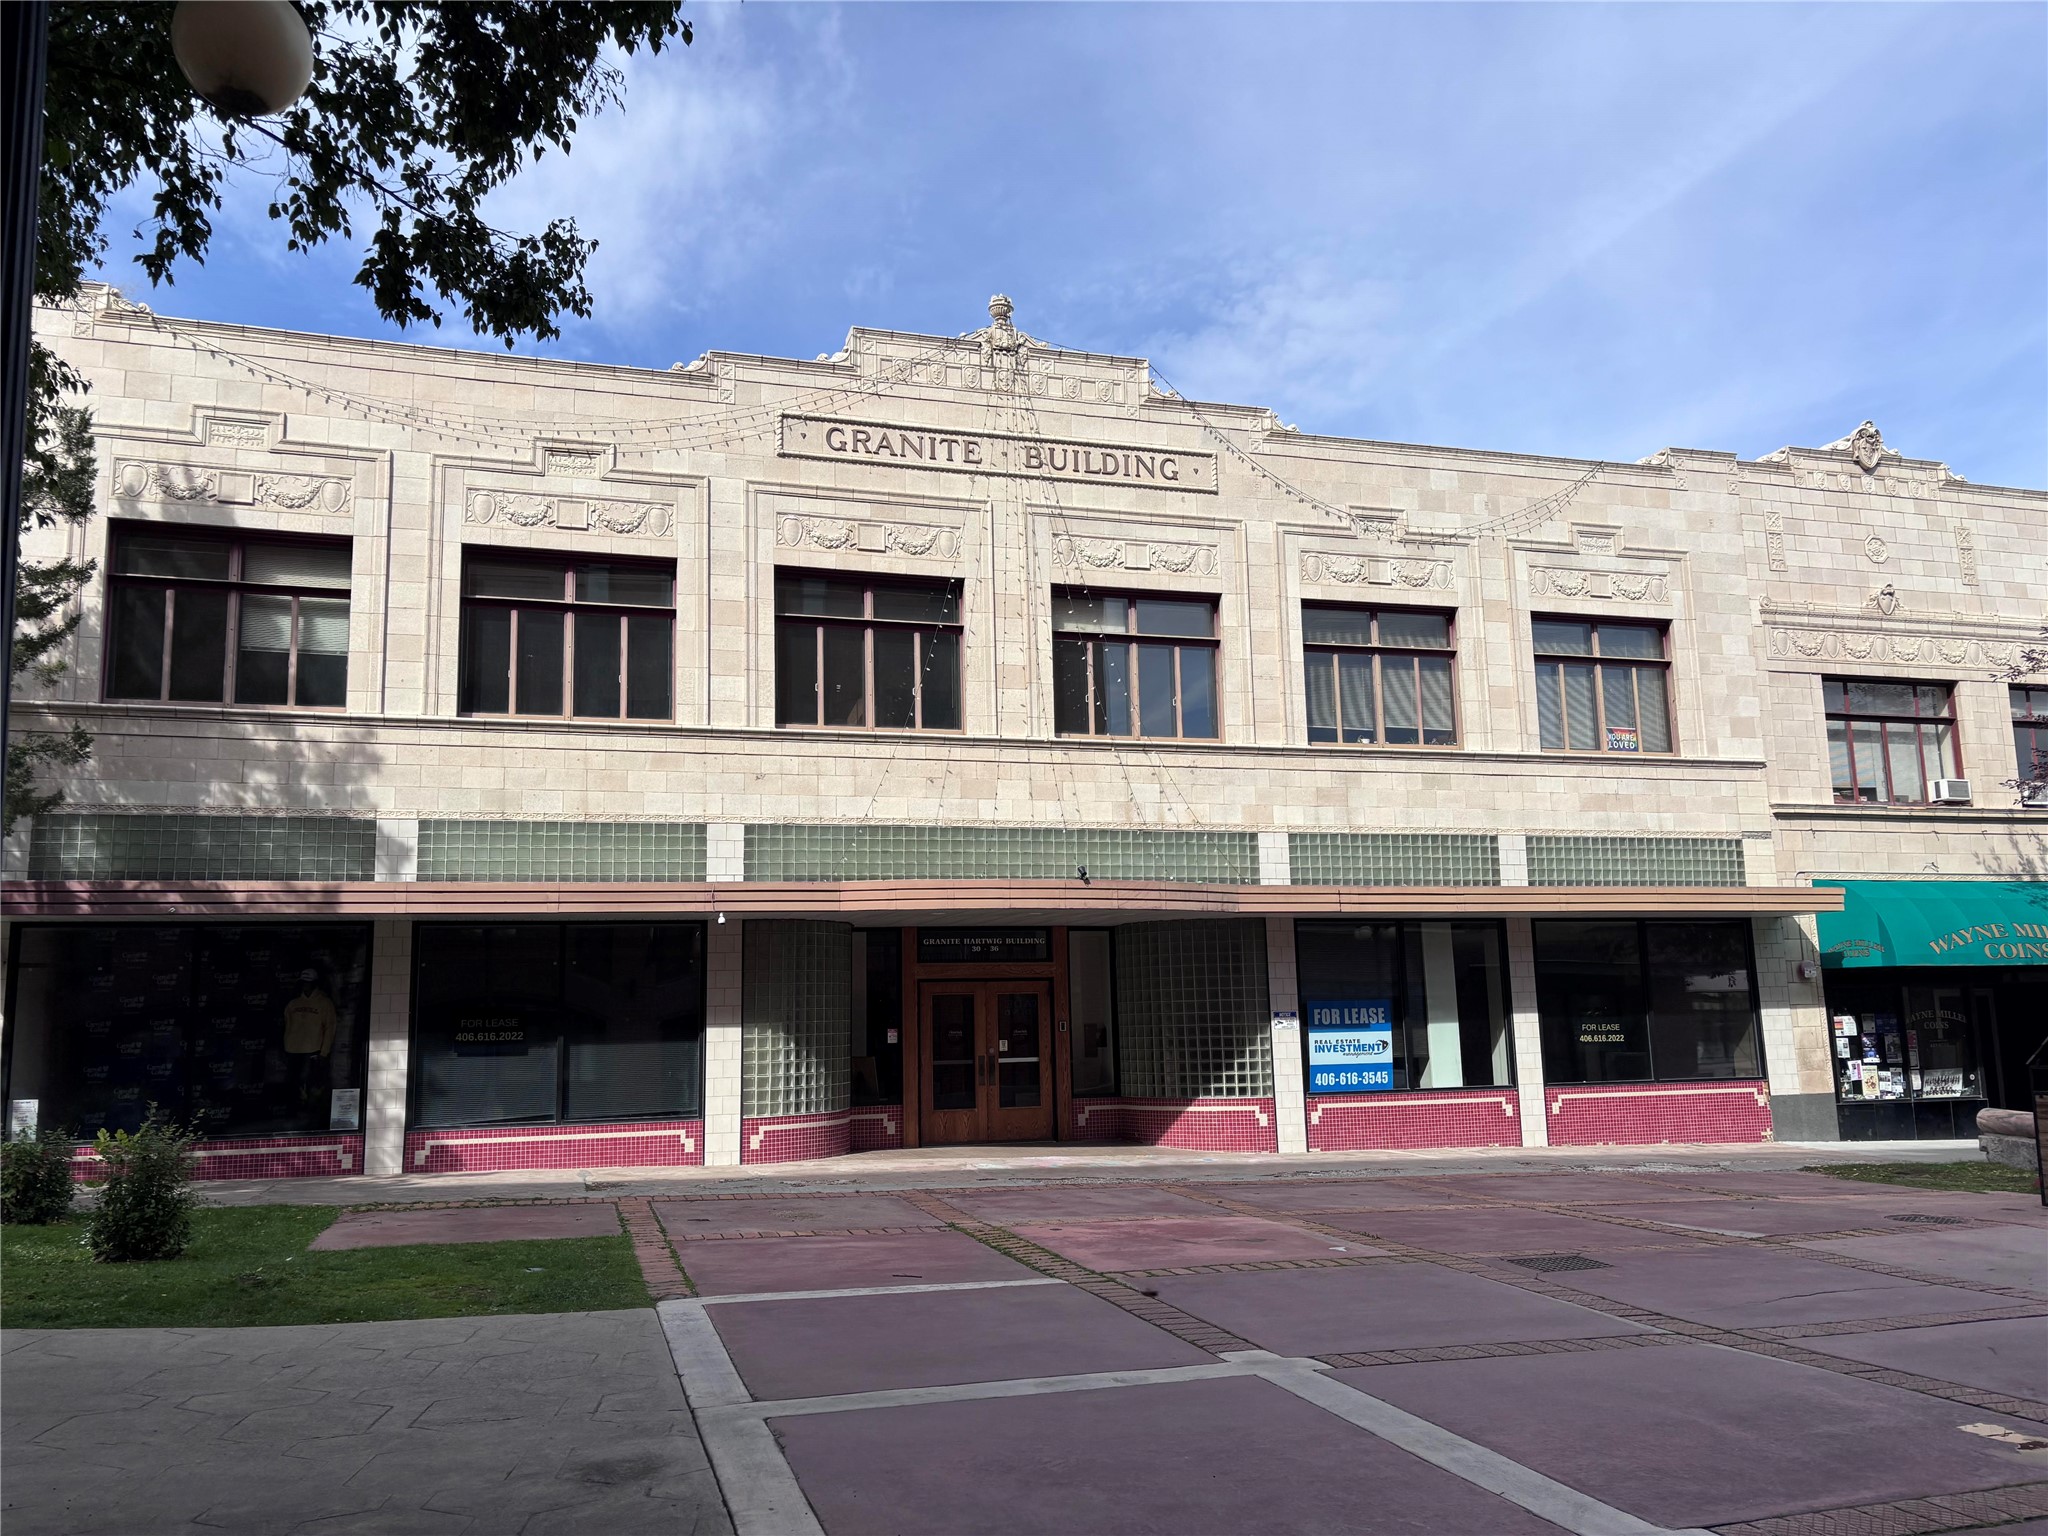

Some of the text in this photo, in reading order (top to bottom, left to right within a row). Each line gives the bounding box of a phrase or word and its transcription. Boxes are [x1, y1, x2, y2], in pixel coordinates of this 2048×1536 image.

[825, 426, 1179, 481] GRANITE BUILDING
[1608, 741, 1635, 749] LOVED
[1005, 937, 1046, 945] BUILDING
[1928, 923, 2009, 955] WAYNE
[1983, 942, 2048, 960] COINS
[1314, 1008, 1341, 1025] FOR
[1344, 1007, 1386, 1025] LEASE
[461, 1018, 519, 1028] FOR LEASE
[1581, 1023, 1621, 1031] FOR LEASE
[455, 1031, 524, 1042] 406.616.2022
[1579, 1034, 1625, 1042] 406.616.2022
[1314, 1043, 1382, 1054] INVESTMENT
[1315, 1071, 1389, 1086] 406-616-3545
